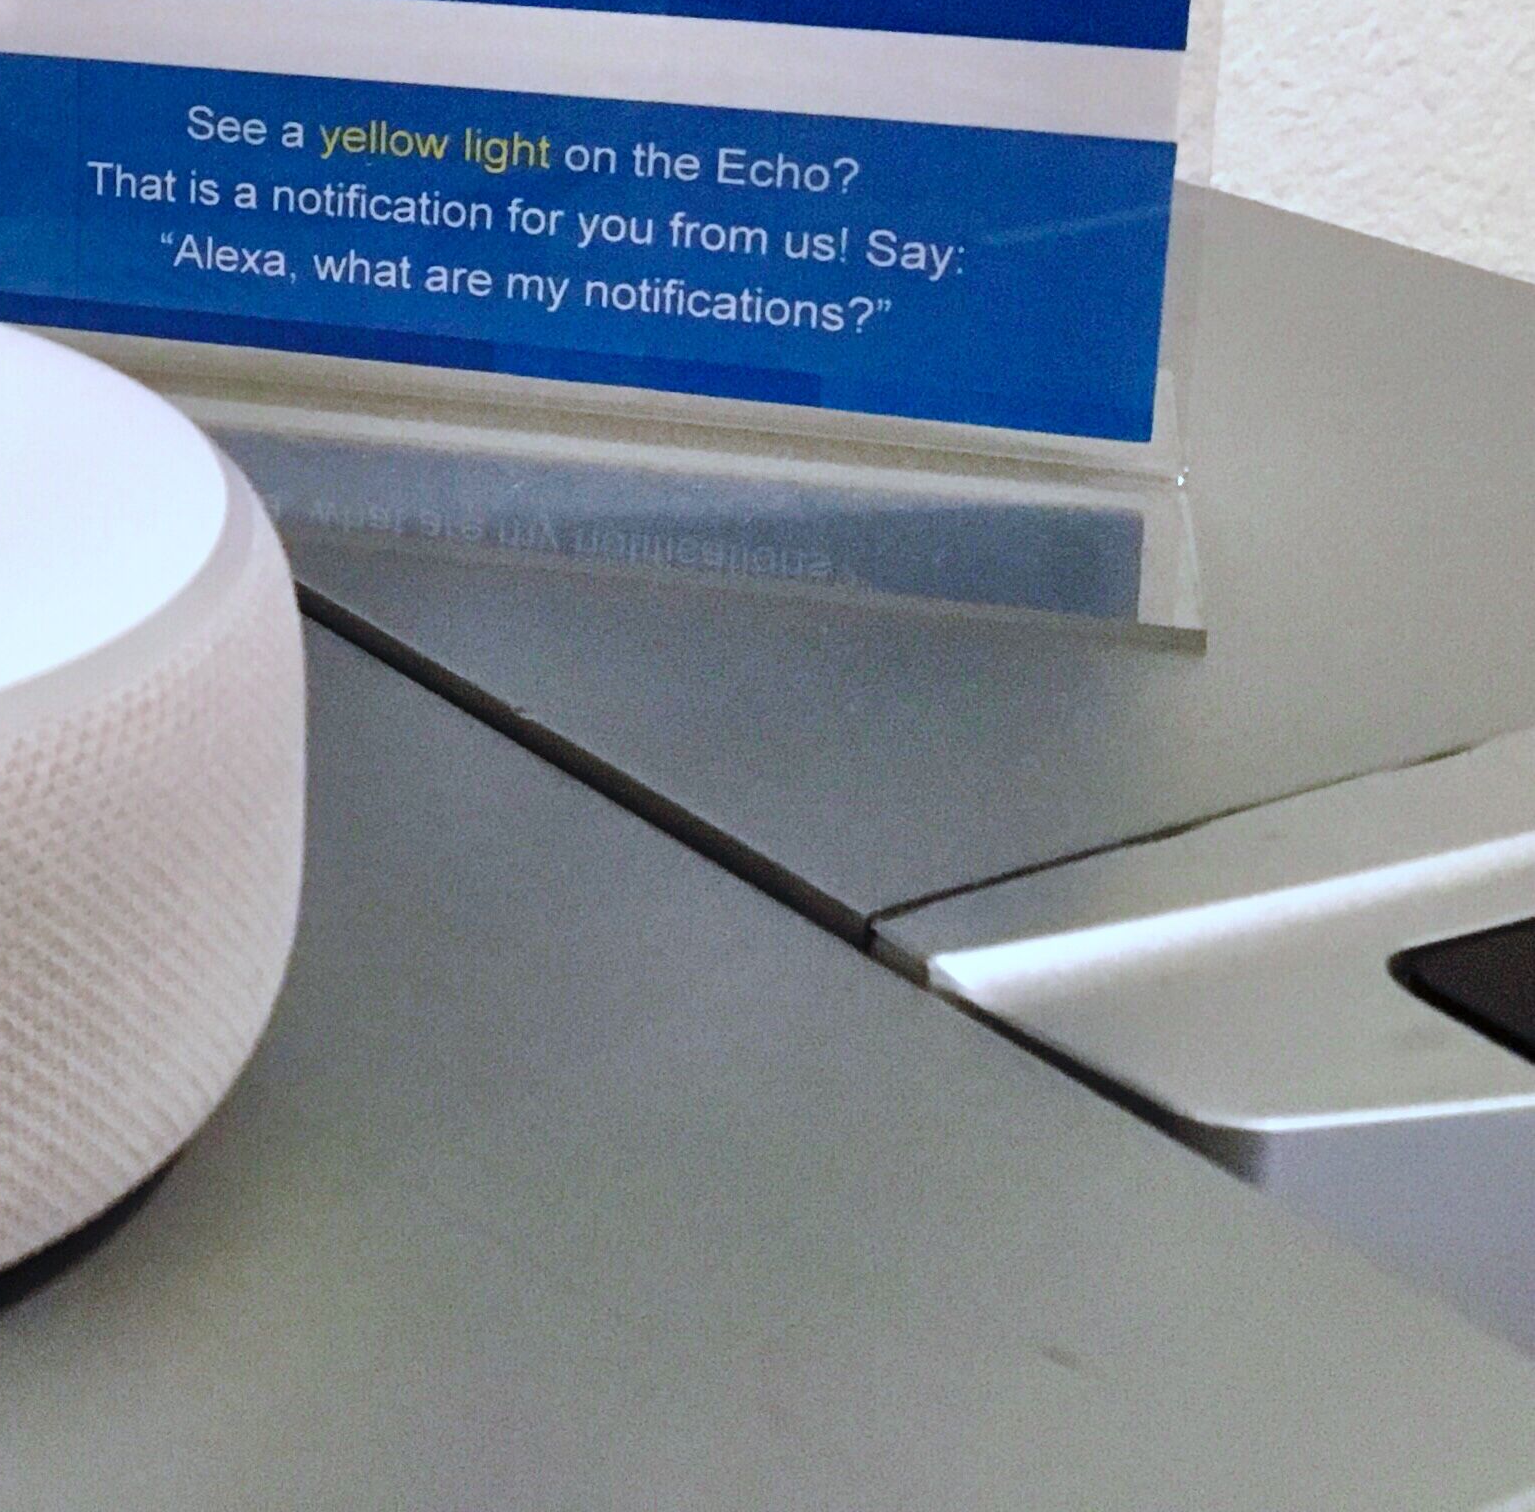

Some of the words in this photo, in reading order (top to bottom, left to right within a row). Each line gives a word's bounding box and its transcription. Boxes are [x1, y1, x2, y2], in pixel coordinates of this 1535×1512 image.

[187, 105, 267, 145] See
[282, 122, 304, 148] a
[321, 120, 449, 159] yellow
[465, 128, 550, 173] light
[565, 145, 616, 173] on
[633, 143, 700, 181] the
[717, 148, 859, 193] Echo?
[88, 161, 176, 202] That
[190, 169, 220, 206] is
[234, 183, 257, 209] a
[273, 183, 492, 230] notification
[508, 198, 564, 235] for
[578, 213, 653, 248] you
[669, 211, 768, 254] from
[785, 227, 848, 262] us!
[866, 229, 964, 281] Say:
[314, 250, 411, 289] what
[425, 266, 492, 297] are
[507, 273, 569, 312] my
